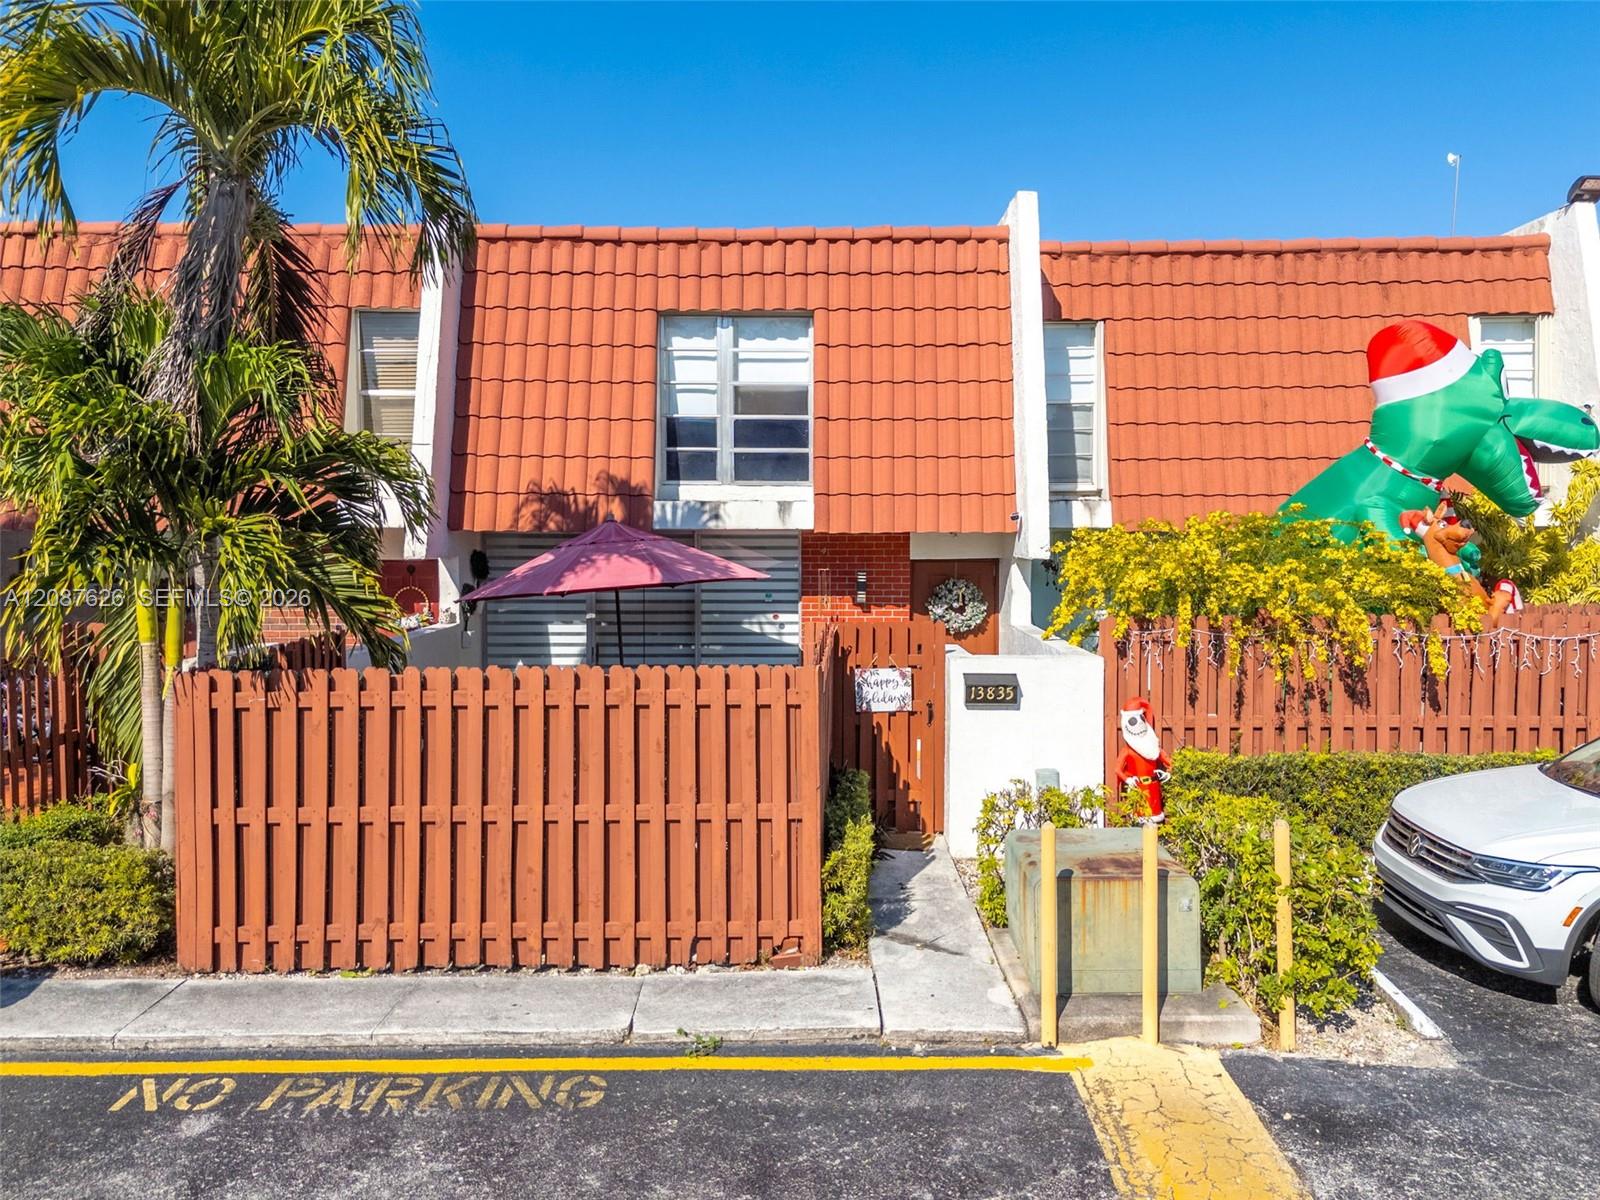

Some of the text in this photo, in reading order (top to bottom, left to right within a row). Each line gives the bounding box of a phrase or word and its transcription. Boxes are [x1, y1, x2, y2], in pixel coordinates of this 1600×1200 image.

[970, 686, 1014, 700] 13835
[107, 1074, 607, 1112] NO PARKING
